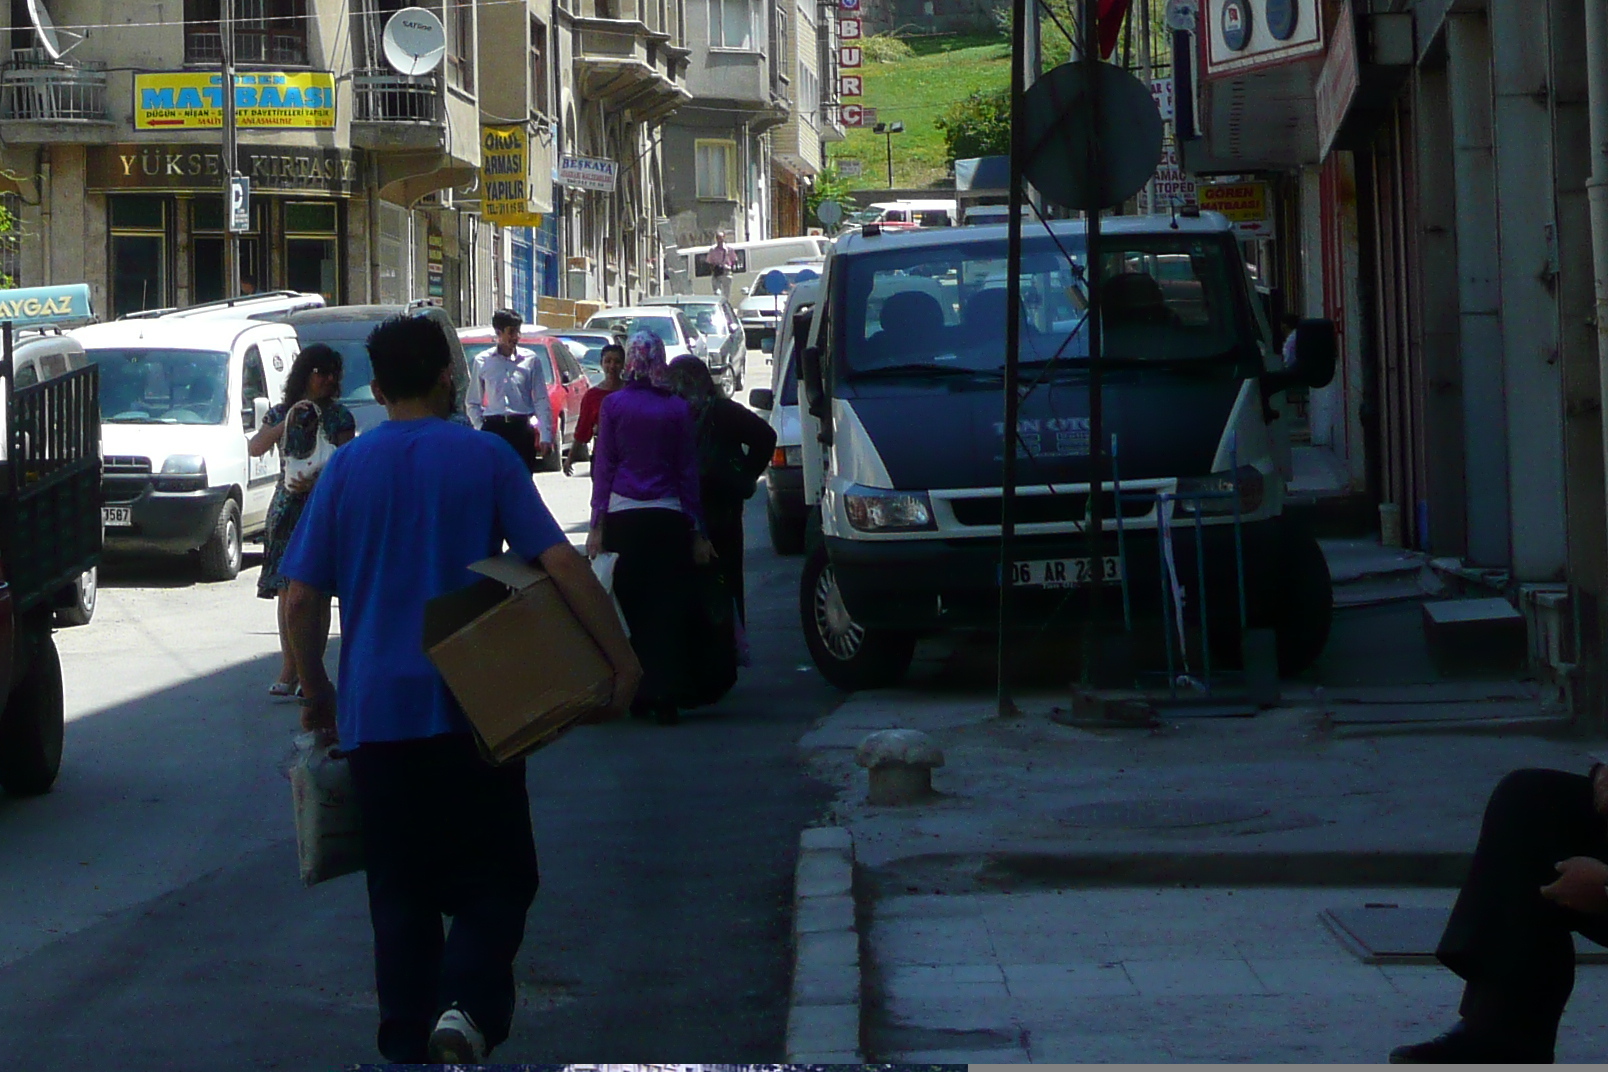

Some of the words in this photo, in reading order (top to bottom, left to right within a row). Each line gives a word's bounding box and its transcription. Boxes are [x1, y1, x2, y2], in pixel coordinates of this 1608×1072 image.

[119, 149, 224, 177] YÜKSE
[484, 154, 522, 175] ARMASI
[485, 180, 524, 201] YAPILIR
[1044, 561, 1066, 582] AR
